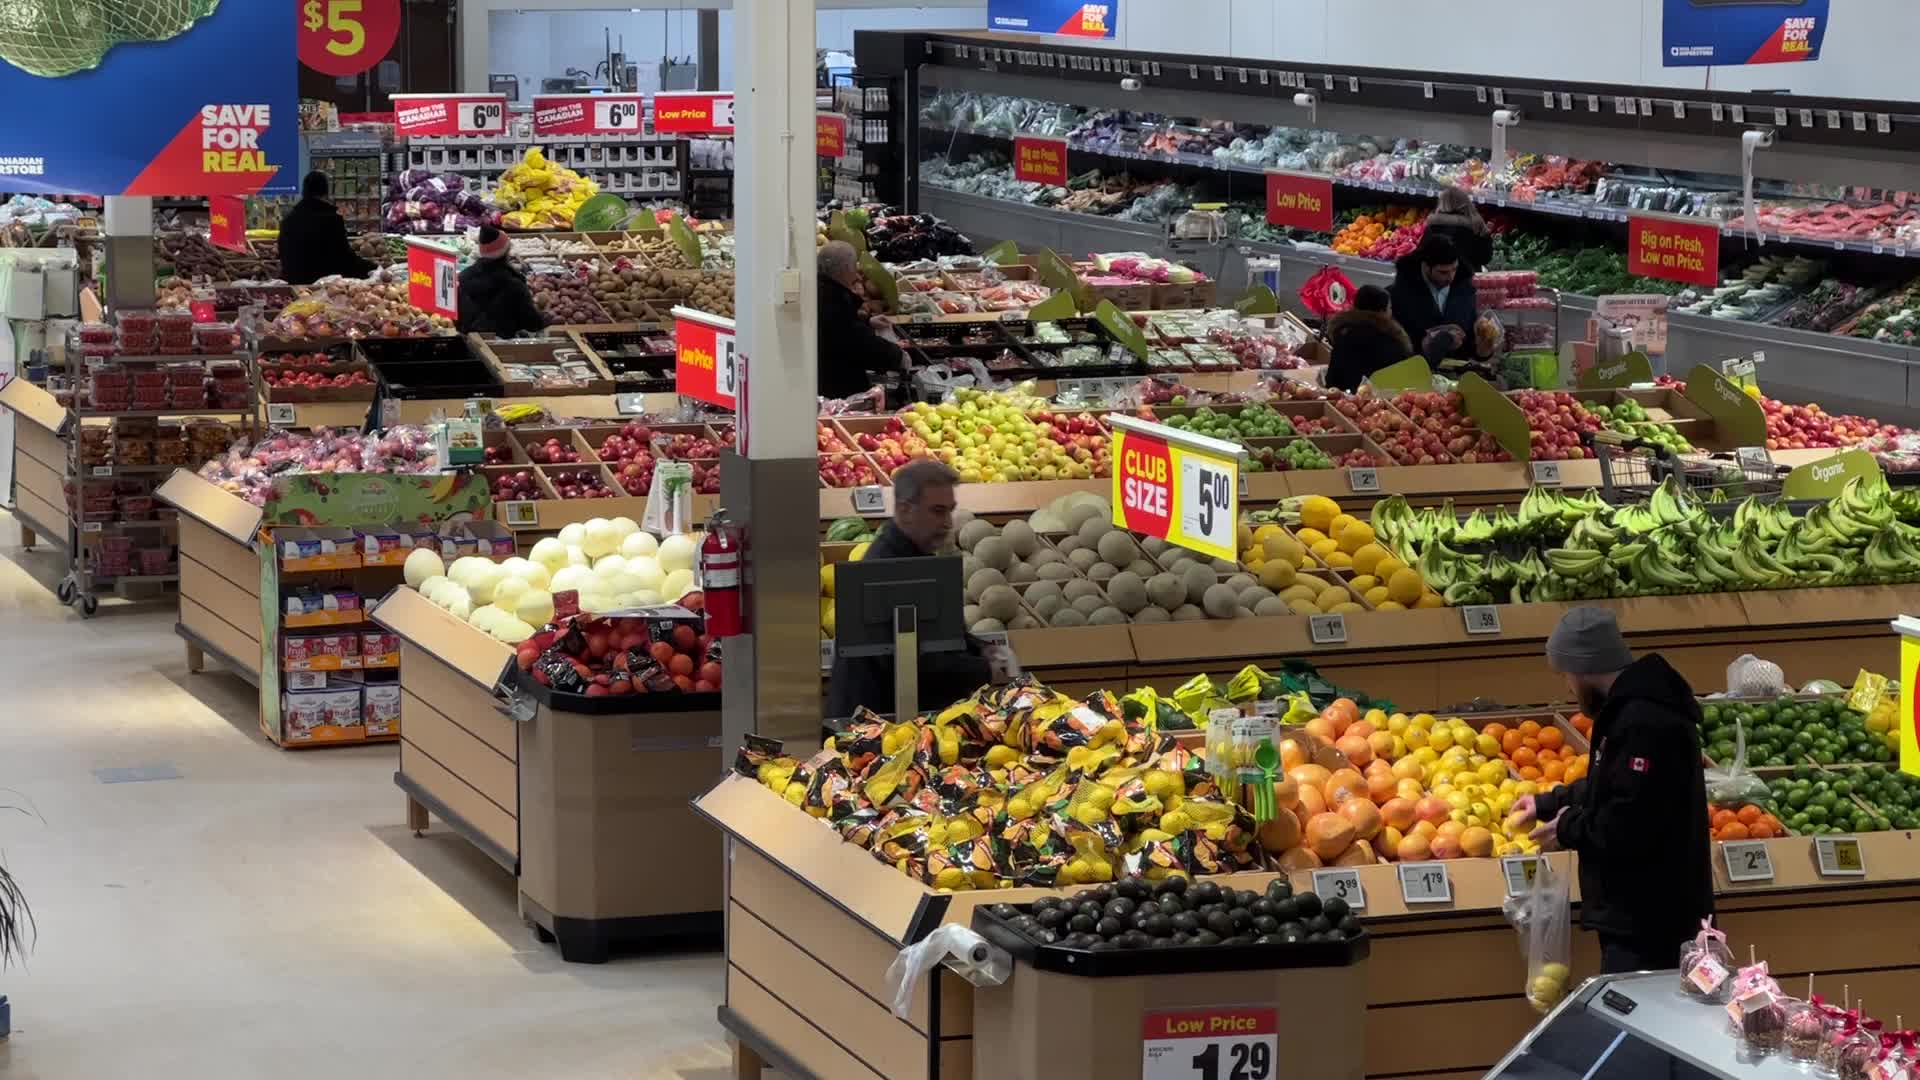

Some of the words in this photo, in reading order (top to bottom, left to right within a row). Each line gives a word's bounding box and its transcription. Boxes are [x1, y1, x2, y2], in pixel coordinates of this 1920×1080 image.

[1082, 14, 1104, 23] FOR
[1083, 4, 1108, 15] SAVE
[1784, 17, 1815, 30] SAVE
[1784, 29, 1808, 41] FOR
[201, 104, 270, 126] SAVE
[400, 109, 447, 124] CANADIAN
[537, 108, 583, 124] CANADIAN
[659, 109, 680, 119] Low
[681, 109, 706, 119] Price
[202, 128, 258, 149] FOR
[1277, 189, 1296, 209] Low
[1298, 191, 1321, 212] Price
[1641, 230, 1657, 249] Big
[1660, 236, 1672, 249] on
[1674, 234, 1704, 256] Fresh,
[1641, 247, 1660, 265] Low
[1663, 253, 1675, 267] on
[1677, 253, 1704, 271] Price.
[680, 344, 695, 366] Low
[695, 347, 713, 371] Price
[1125, 448, 1168, 483] CLUB
[1811, 460, 1846, 482] Organic
[1124, 477, 1168, 518] SIZE
[1167, 1017, 1204, 1033] Low
[1210, 1015, 1256, 1031] Price
